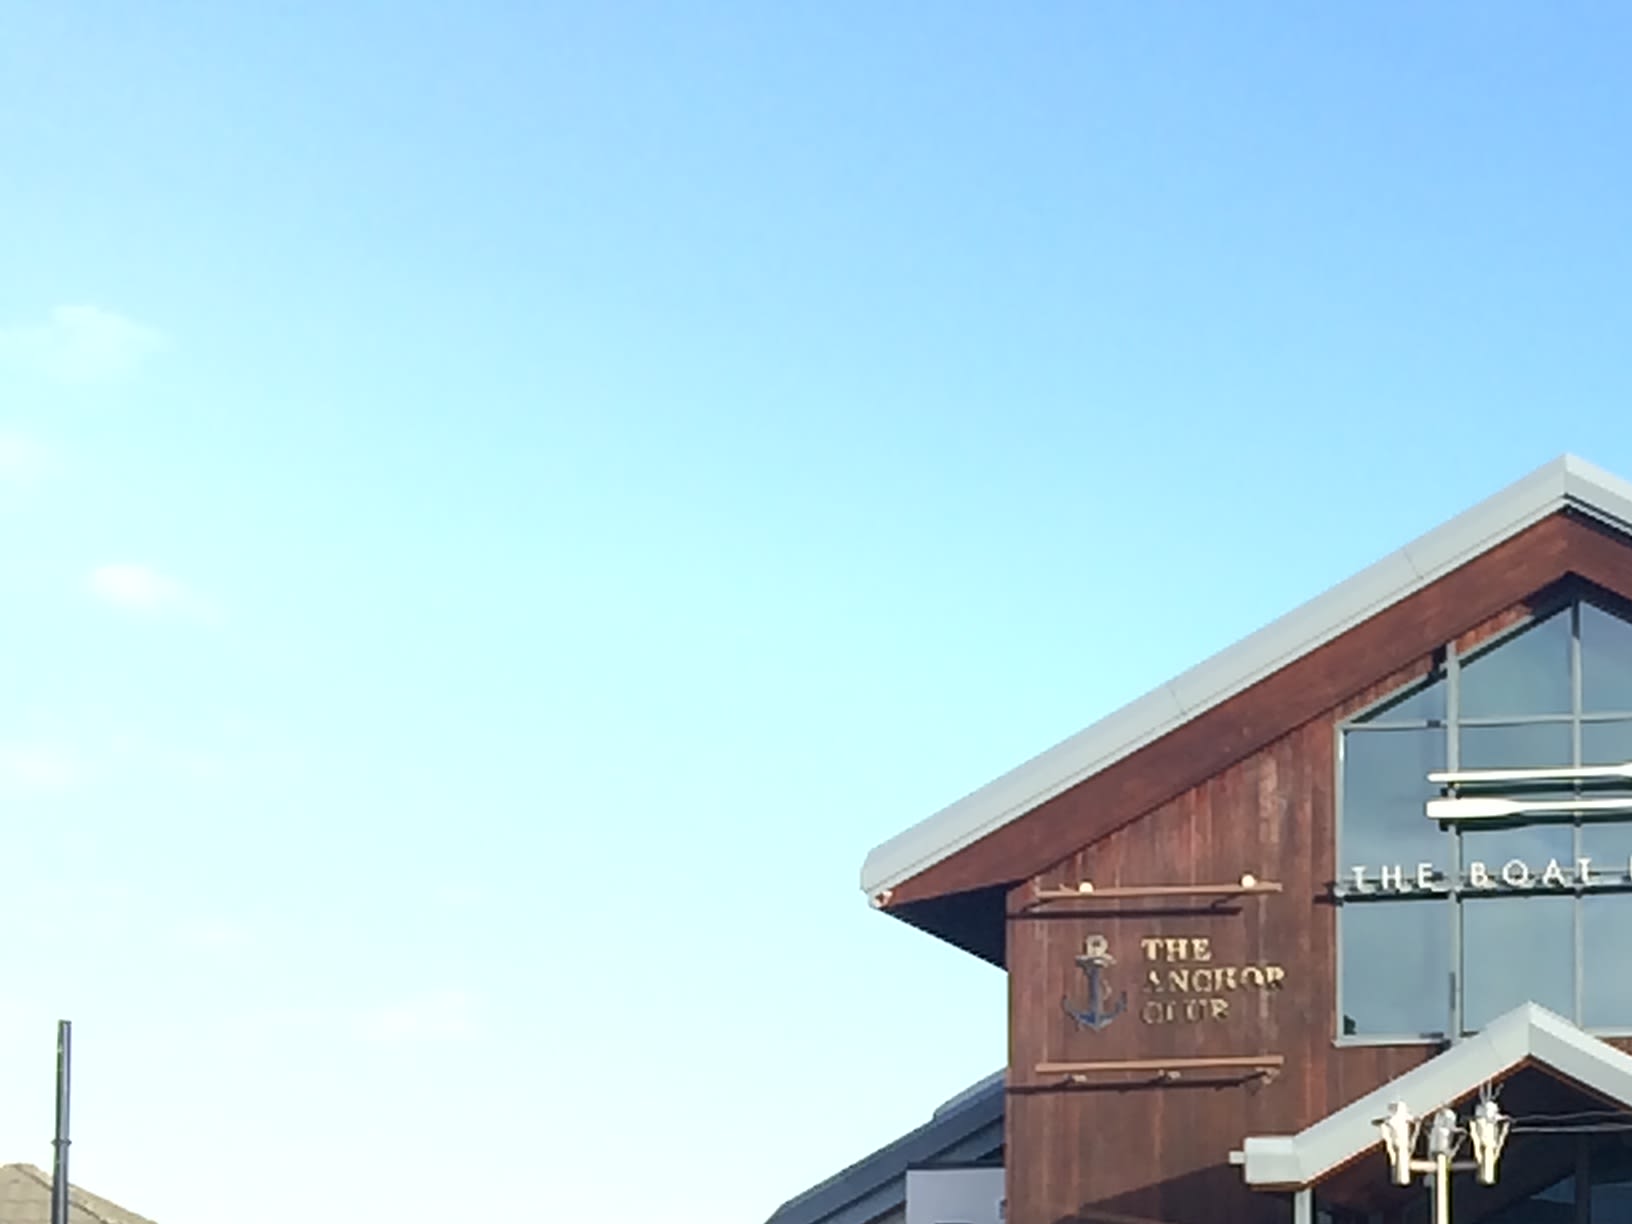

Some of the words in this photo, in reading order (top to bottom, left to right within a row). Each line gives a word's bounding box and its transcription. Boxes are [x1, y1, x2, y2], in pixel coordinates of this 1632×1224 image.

[1352, 862, 1434, 889] THE
[1469, 857, 1592, 887] BOAT
[1140, 938, 1212, 962] THE
[1143, 966, 1285, 992] ANCHOR
